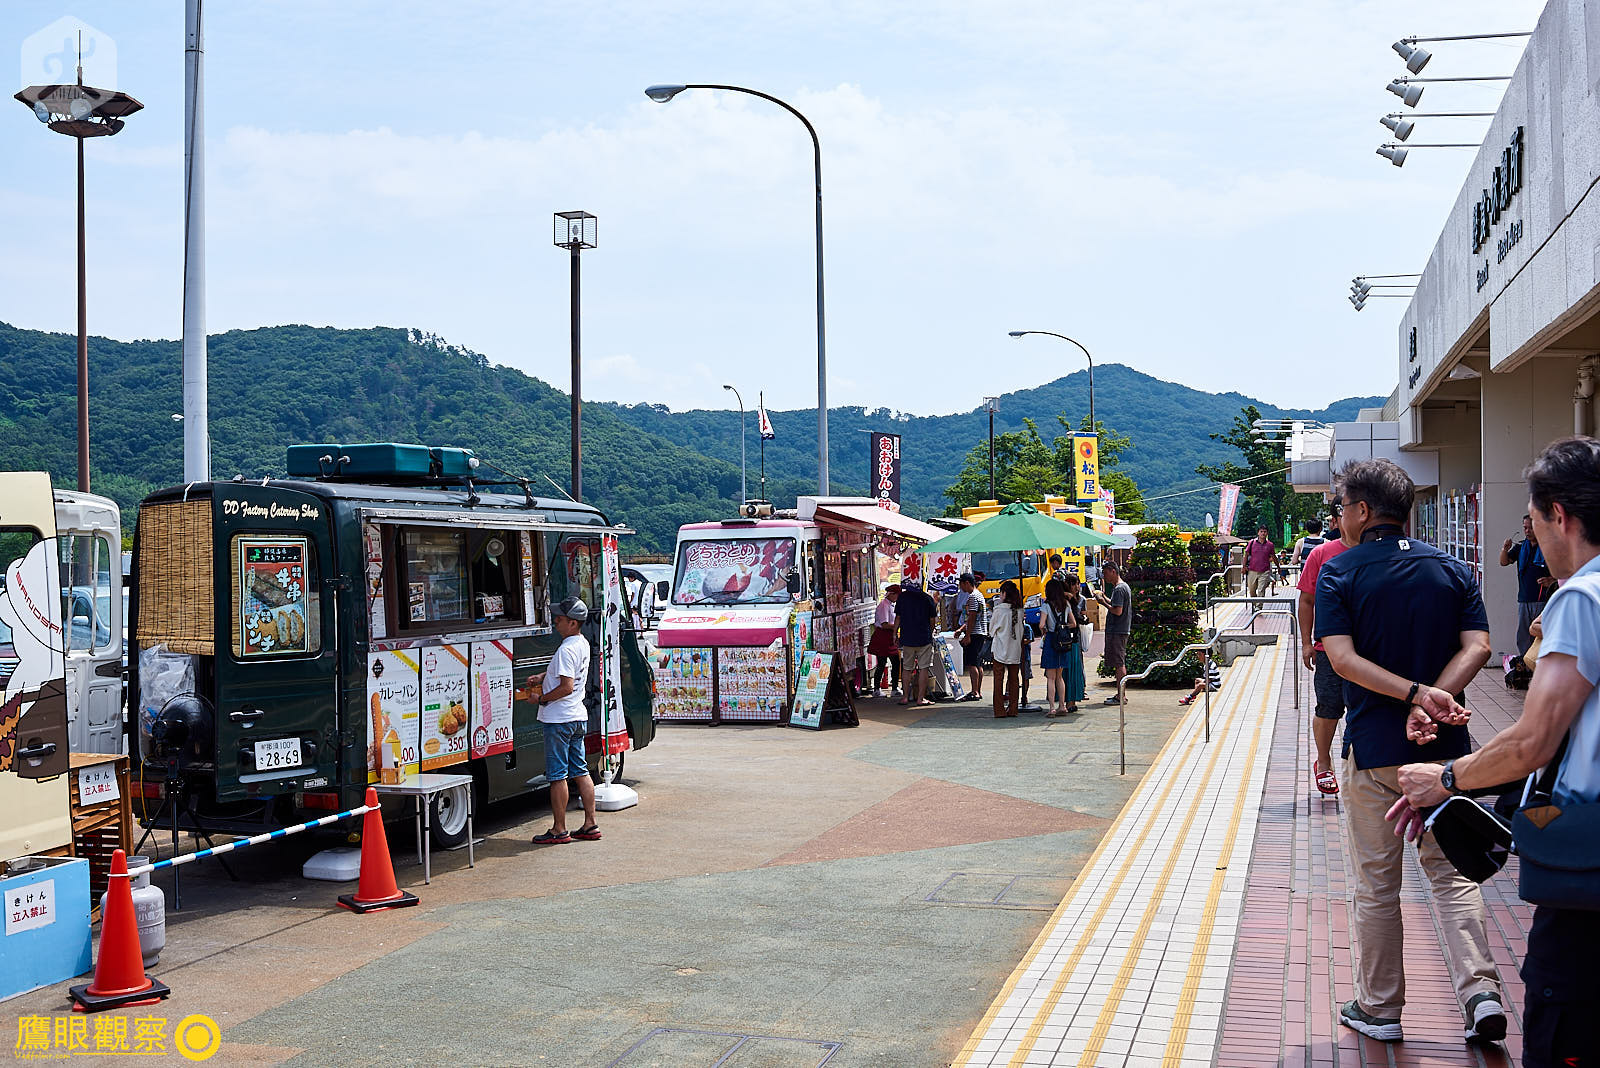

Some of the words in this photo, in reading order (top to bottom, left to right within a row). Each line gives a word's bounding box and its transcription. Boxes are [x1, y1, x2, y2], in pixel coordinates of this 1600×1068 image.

[1081, 460, 1096, 495] 松屋
[223, 500, 239, 514] DD
[241, 501, 268, 519] Factory
[270, 502, 299, 521] Catering
[301, 504, 319, 520] Shop
[689, 543, 755, 562] とちおとめ
[903, 552, 921, 580] 氷
[935, 554, 958, 578] 氷
[275, 567, 302, 601] 牛串
[246, 613, 275, 652] メンチ
[379, 684, 418, 700] カレーパン
[425, 679, 466, 696] 和牛メンチ
[494, 726, 509, 741] 800
[448, 736, 464, 752] 350
[266, 749, 299, 767] 28-69
[401, 746, 415, 762] 00
[85, 771, 110, 783] きけん
[84, 783, 112, 796] 立入禁止
[14, 891, 46, 907] きけん
[12, 906, 48, 923] 立入禁止
